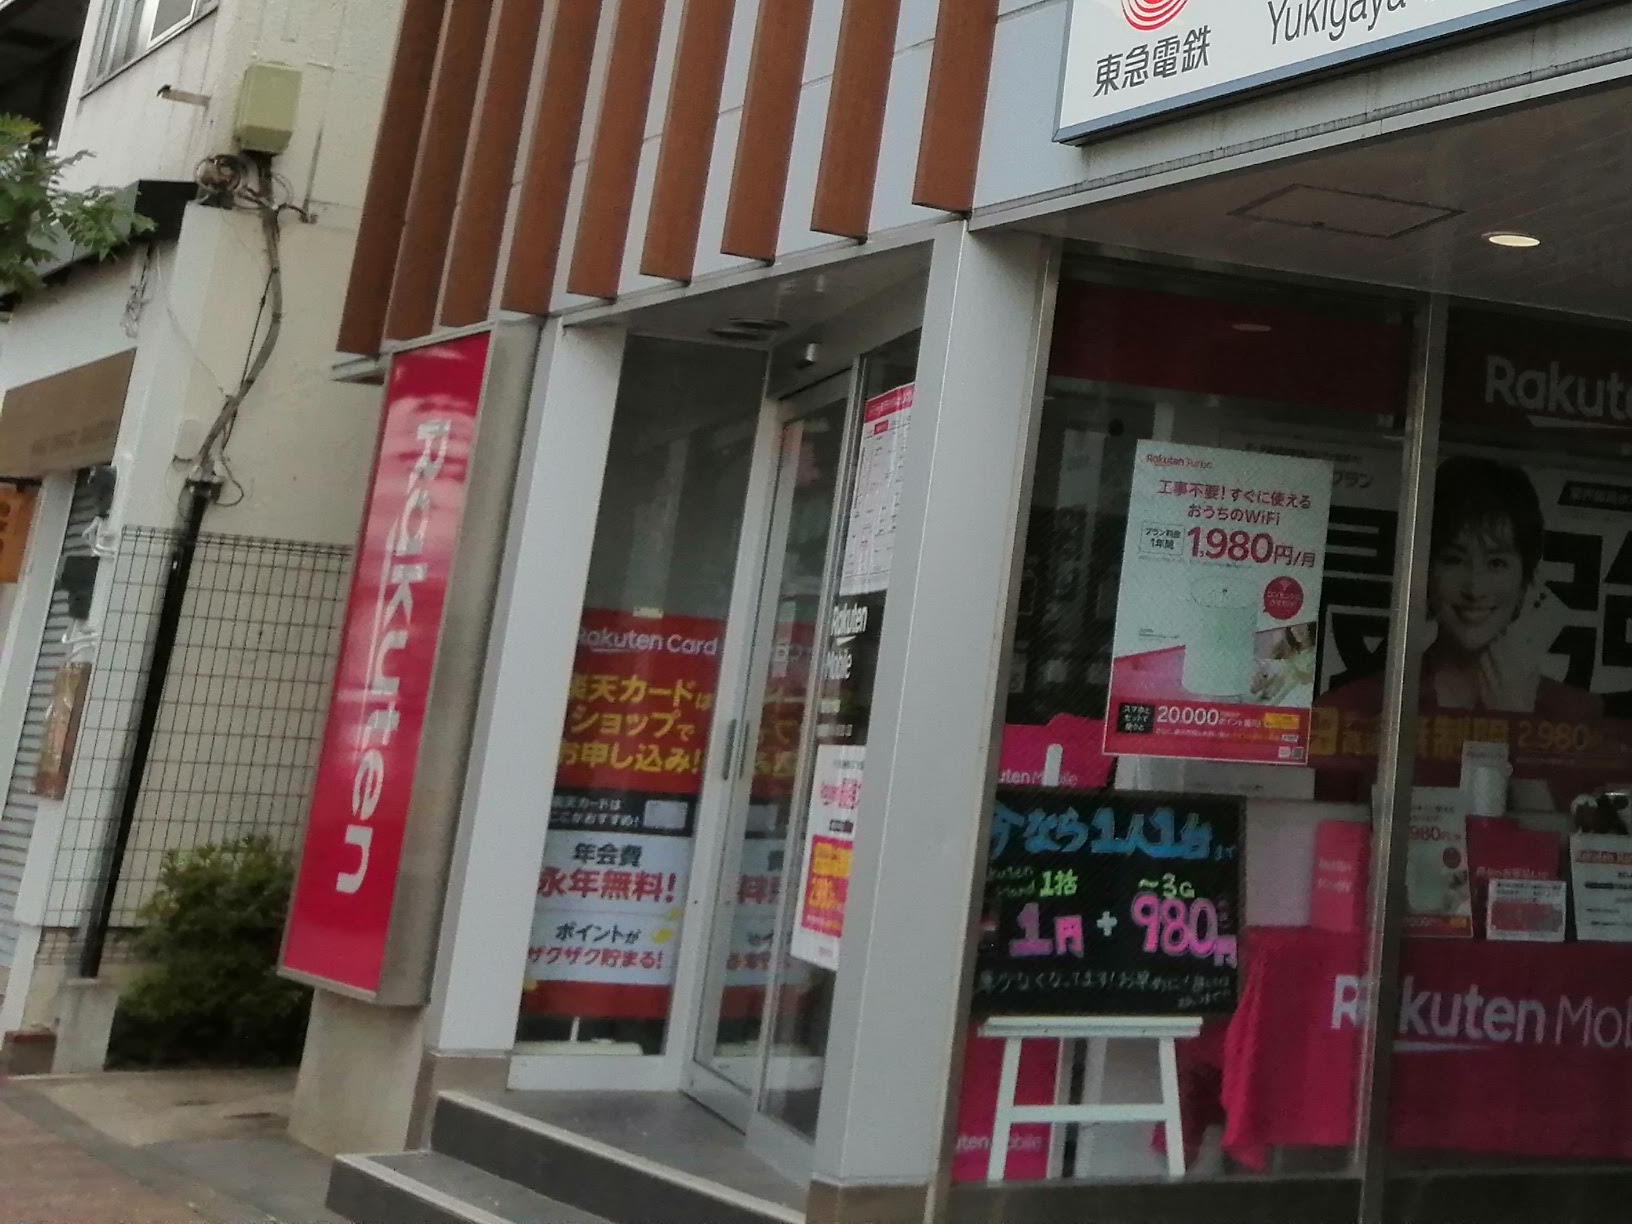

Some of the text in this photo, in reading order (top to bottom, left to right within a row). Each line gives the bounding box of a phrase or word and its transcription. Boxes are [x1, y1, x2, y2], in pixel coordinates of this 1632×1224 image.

[1093, 24, 1211, 98] 東急電鉄
[831, 603, 869, 637] Rakuten
[333, 418, 450, 895] Rakuten
[666, 633, 719, 656] Card
[569, 704, 696, 742] ショップで
[573, 842, 642, 867] 年会費
[556, 922, 641, 944] ポイントが
